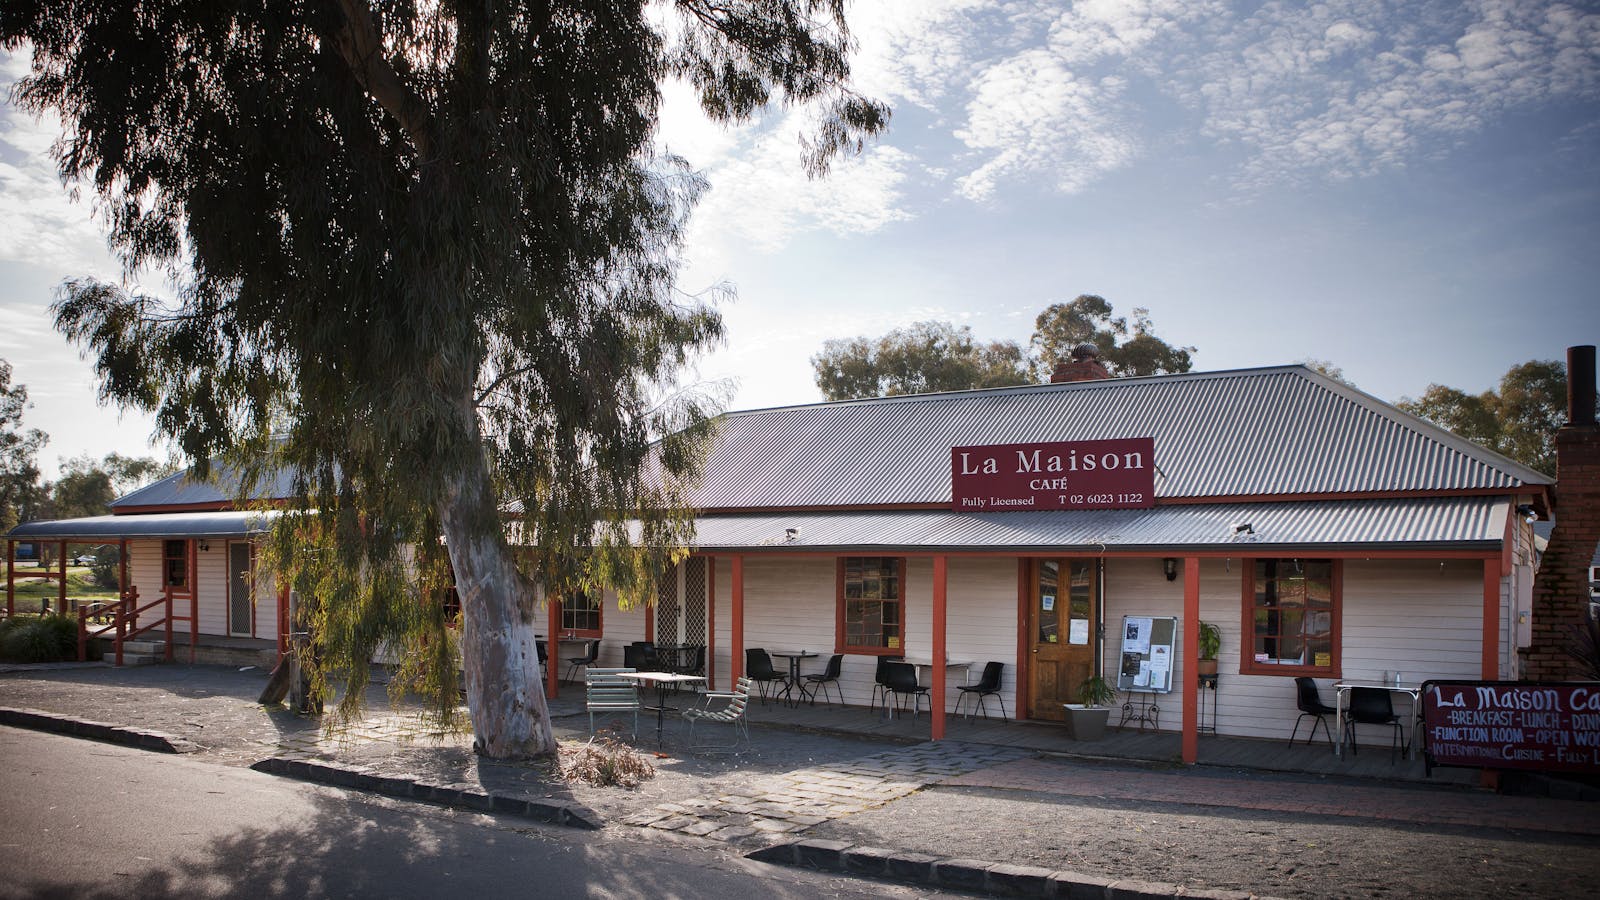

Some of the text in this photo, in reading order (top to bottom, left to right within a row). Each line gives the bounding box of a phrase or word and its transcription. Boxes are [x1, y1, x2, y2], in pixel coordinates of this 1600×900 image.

[960, 449, 1144, 475] La Maison
[1029, 476, 1068, 491] CAFÉ
[962, 495, 1035, 509] Fully Licensed
[1058, 493, 1143, 504] T 02 6023 1122
[1433, 686, 1466, 708] La
[1475, 686, 1562, 712] Maison
[1492, 727, 1524, 743] ROOM
